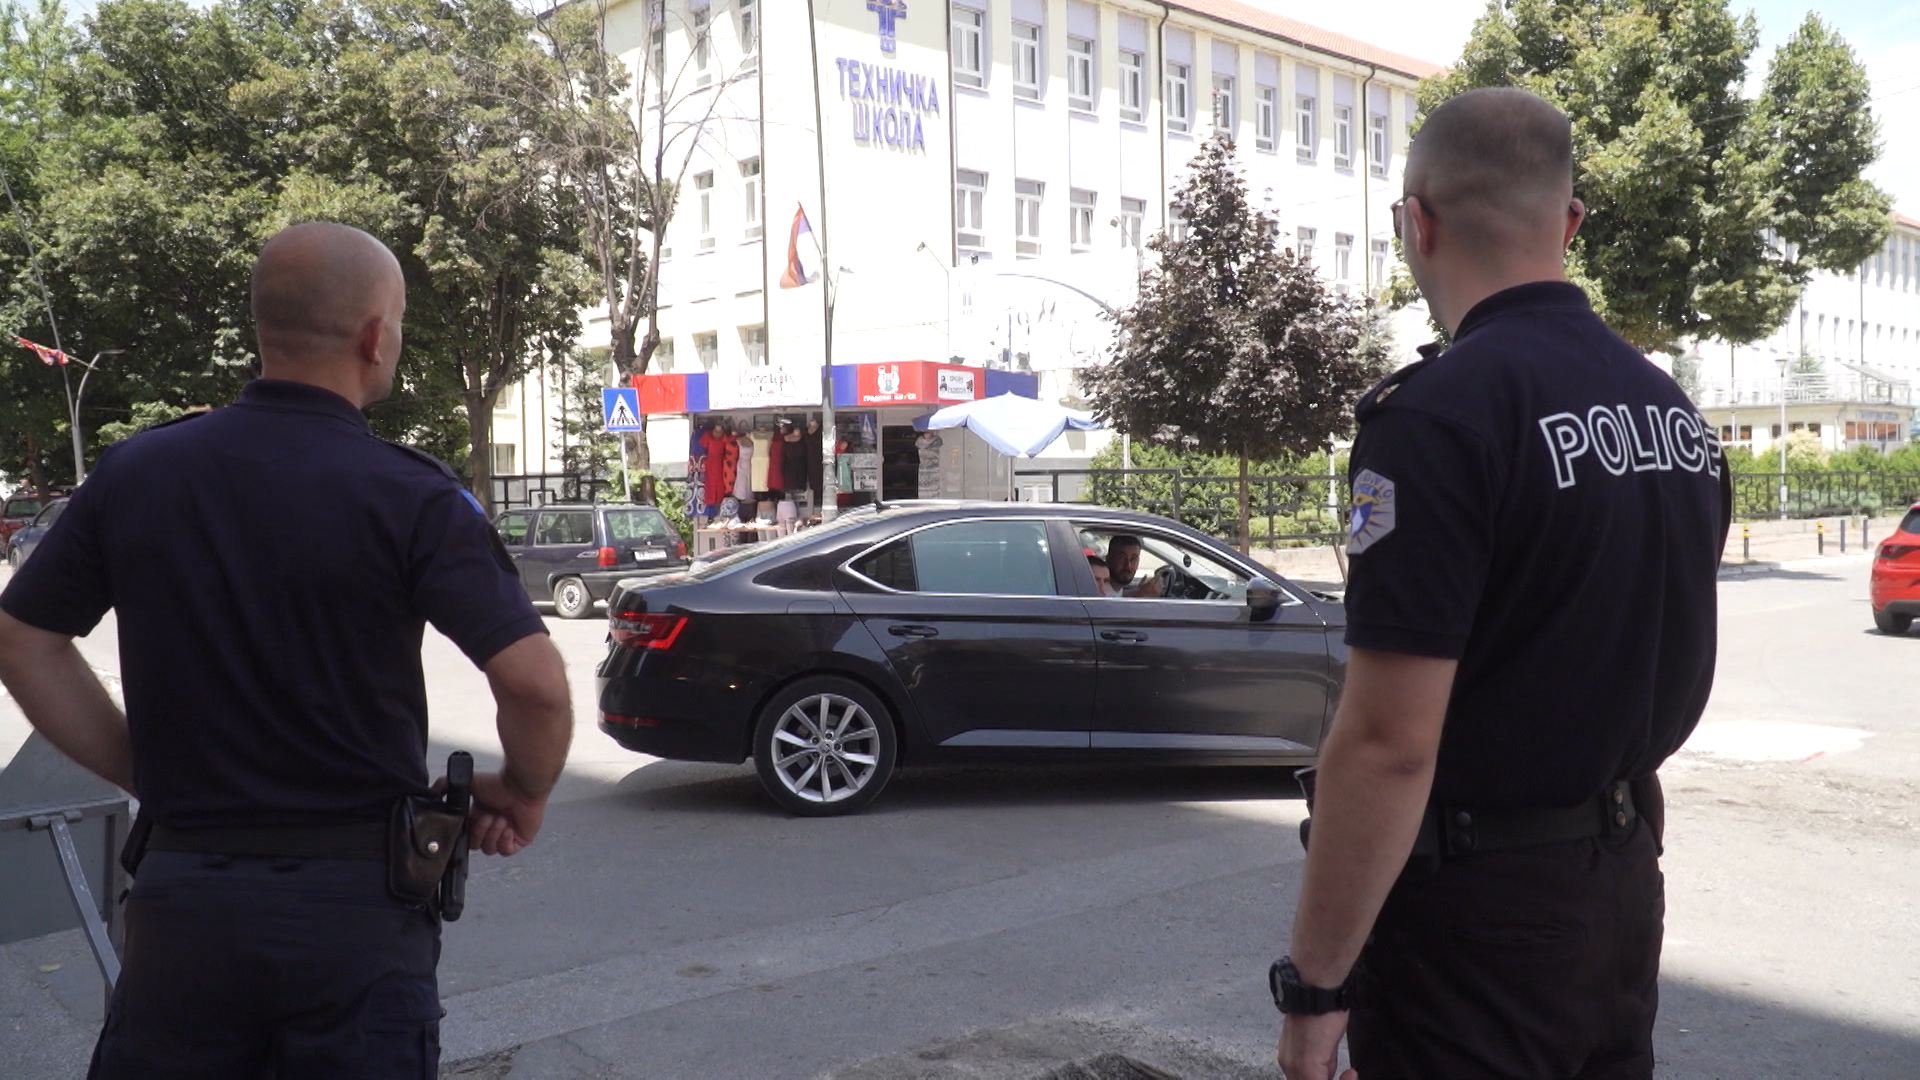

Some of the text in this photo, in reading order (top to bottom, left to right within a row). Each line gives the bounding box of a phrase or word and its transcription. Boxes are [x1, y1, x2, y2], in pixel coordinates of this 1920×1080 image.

[835, 57, 940, 116] ТЕХНИЧКА
[852, 101, 926, 153] ШКОЛА
[1538, 404, 1722, 490] POLICE
